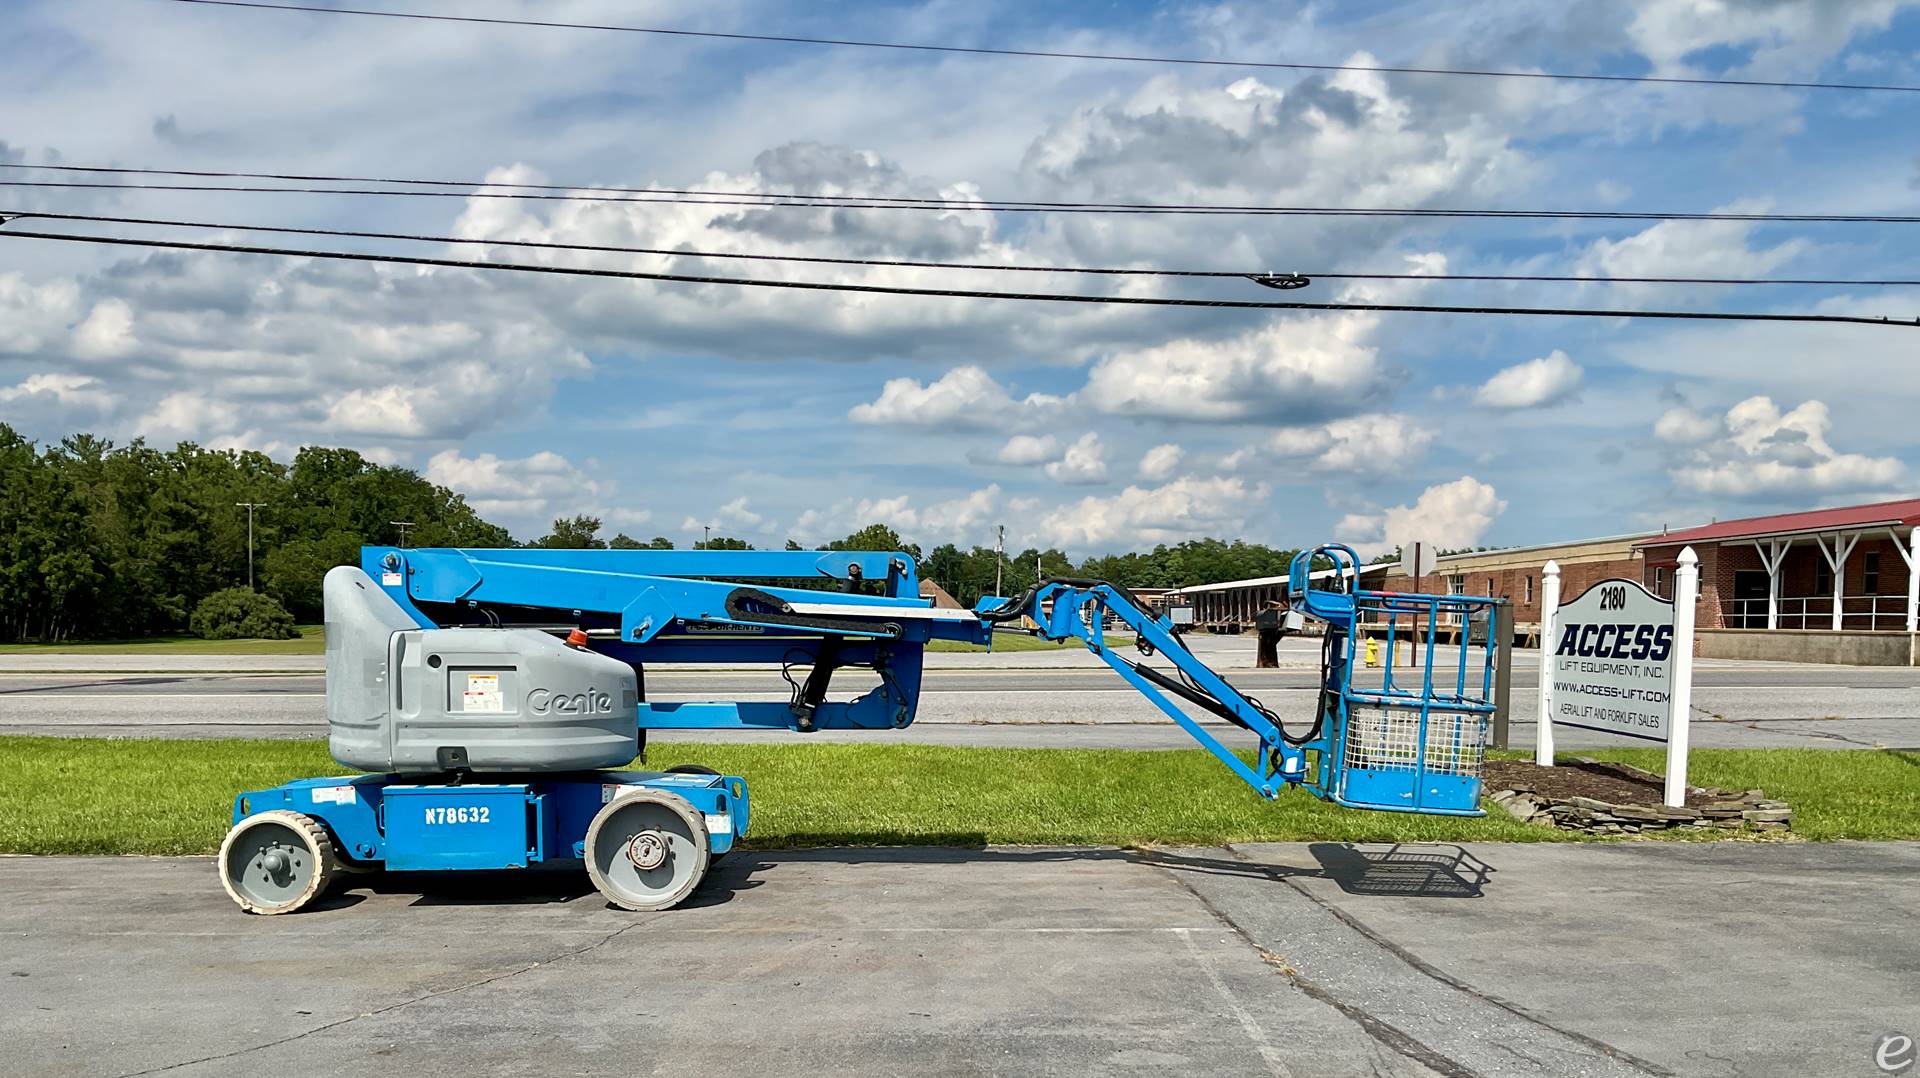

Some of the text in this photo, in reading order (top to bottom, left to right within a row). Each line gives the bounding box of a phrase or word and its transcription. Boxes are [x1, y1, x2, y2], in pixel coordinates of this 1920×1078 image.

[1600, 586, 1626, 610] 2180
[1555, 624, 1674, 661] ACCESS
[1559, 661, 1665, 679] LIFT EQUIPMENT, INC.
[526, 686, 612, 716] Genie
[1560, 703, 1660, 729] AERIAL LIFT AND FORKLIFT SALES
[425, 807, 490, 825] N78632
